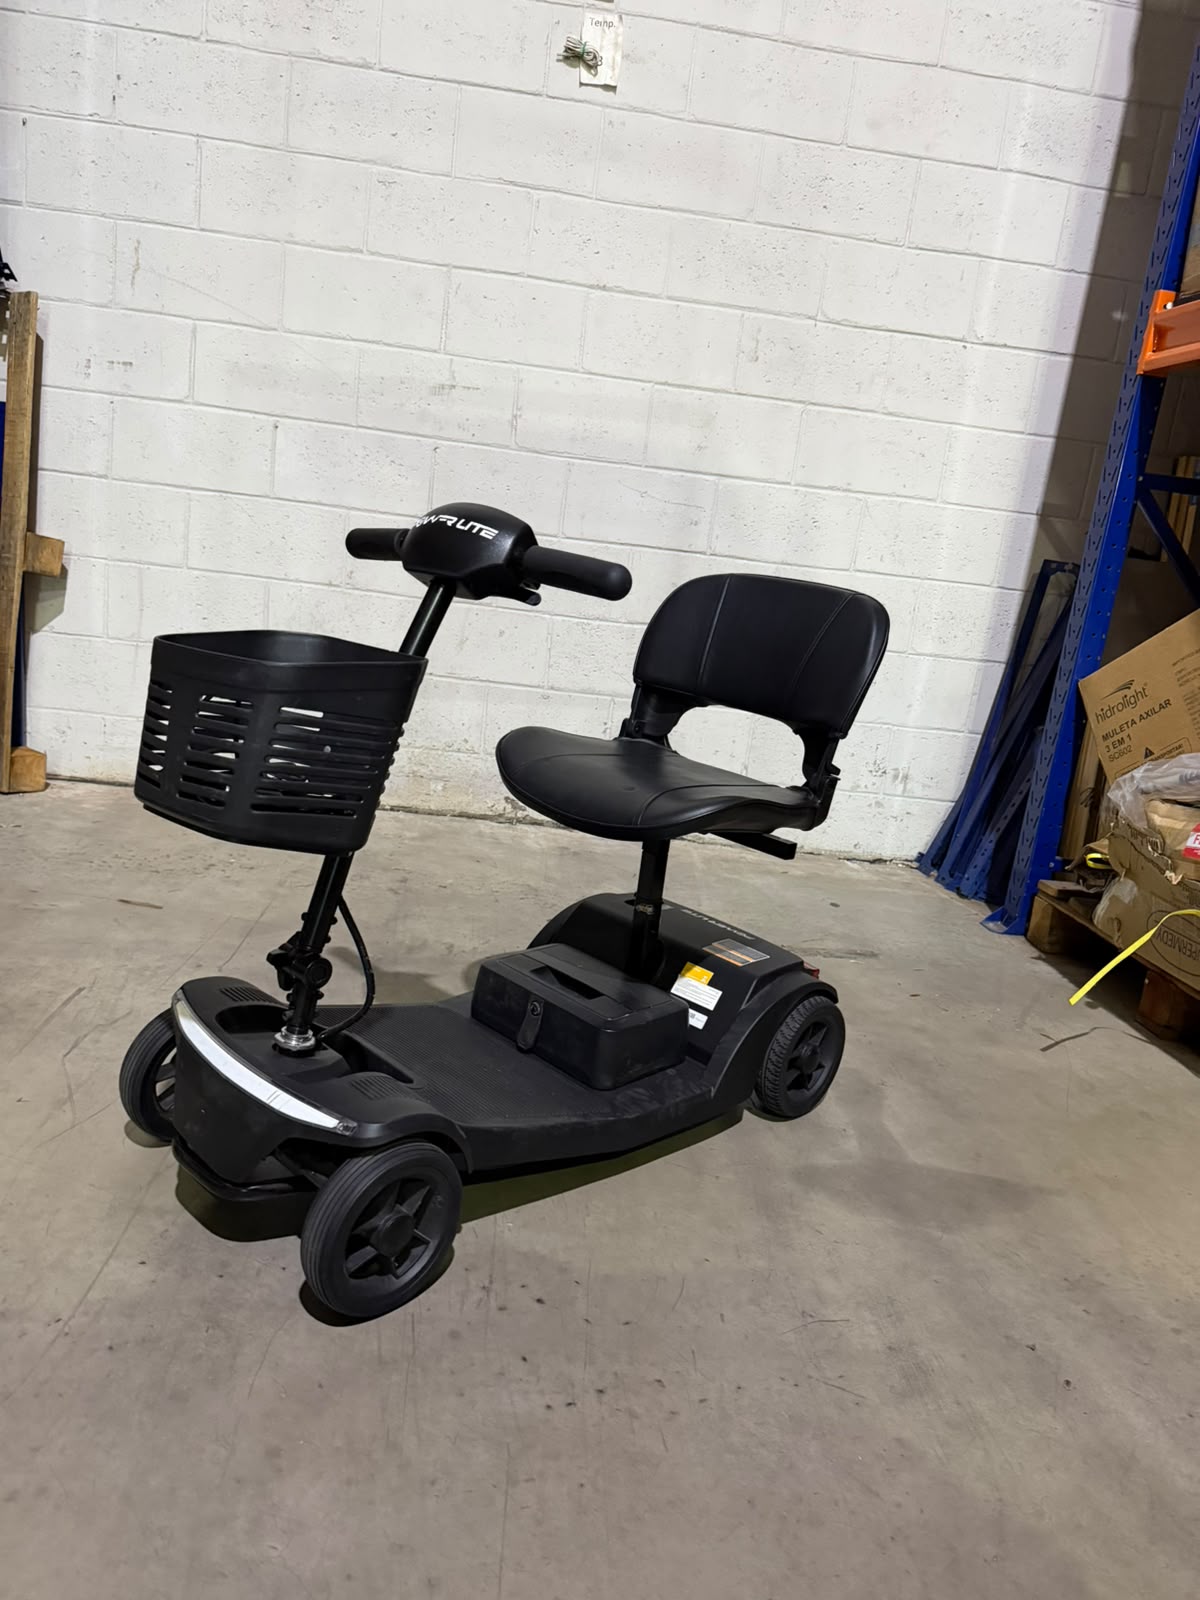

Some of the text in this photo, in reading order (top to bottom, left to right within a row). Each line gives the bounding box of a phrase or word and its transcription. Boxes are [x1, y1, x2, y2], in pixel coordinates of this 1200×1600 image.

[1095, 687, 1148, 723] hidrolight
[1102, 718, 1137, 742] MULETA
[1139, 699, 1172, 723] AXILAR
[1105, 733, 1133, 754] 3 EM 1
